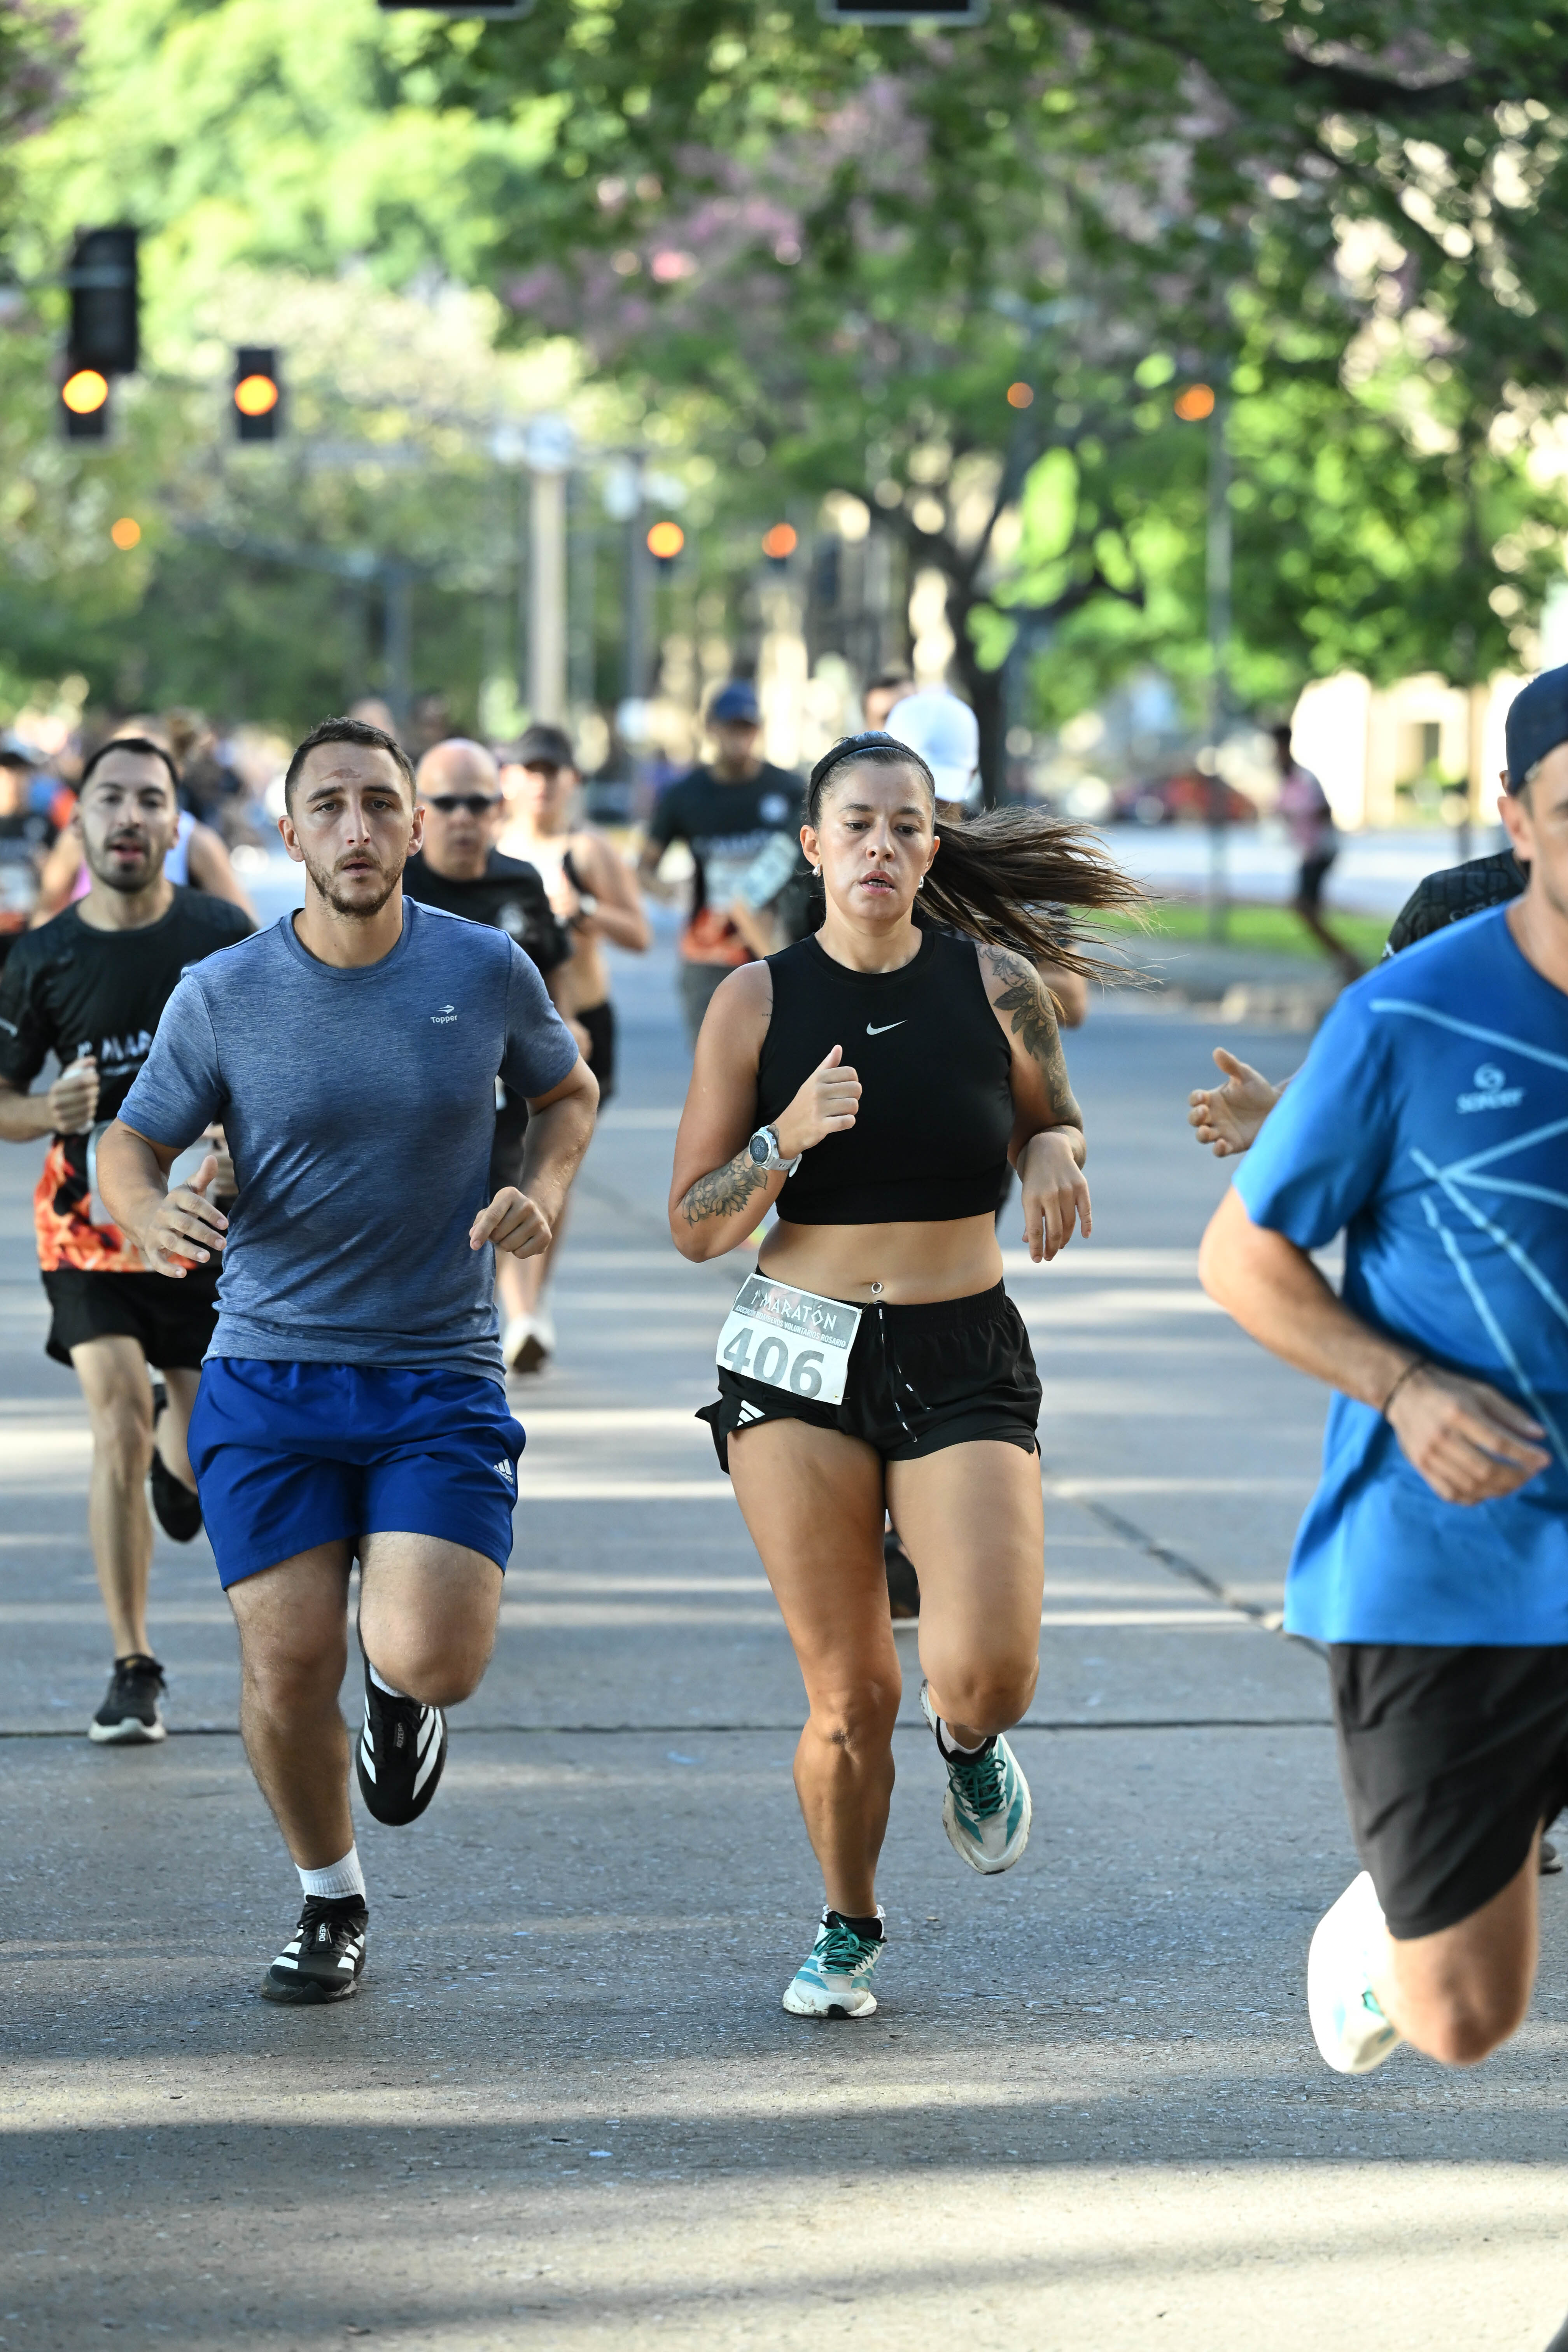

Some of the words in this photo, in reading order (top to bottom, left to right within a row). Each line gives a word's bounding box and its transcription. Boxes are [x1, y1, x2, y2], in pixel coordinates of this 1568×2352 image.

[430, 1015, 457, 1024] Topper
[755, 1311, 783, 1327] BOMBEROS
[784, 1321, 820, 1339] VOLUNTARIOS
[821, 1334, 846, 1348] ROSARIO
[759, 1292, 837, 1331] MARATÓN
[723, 1327, 824, 1398] 406
